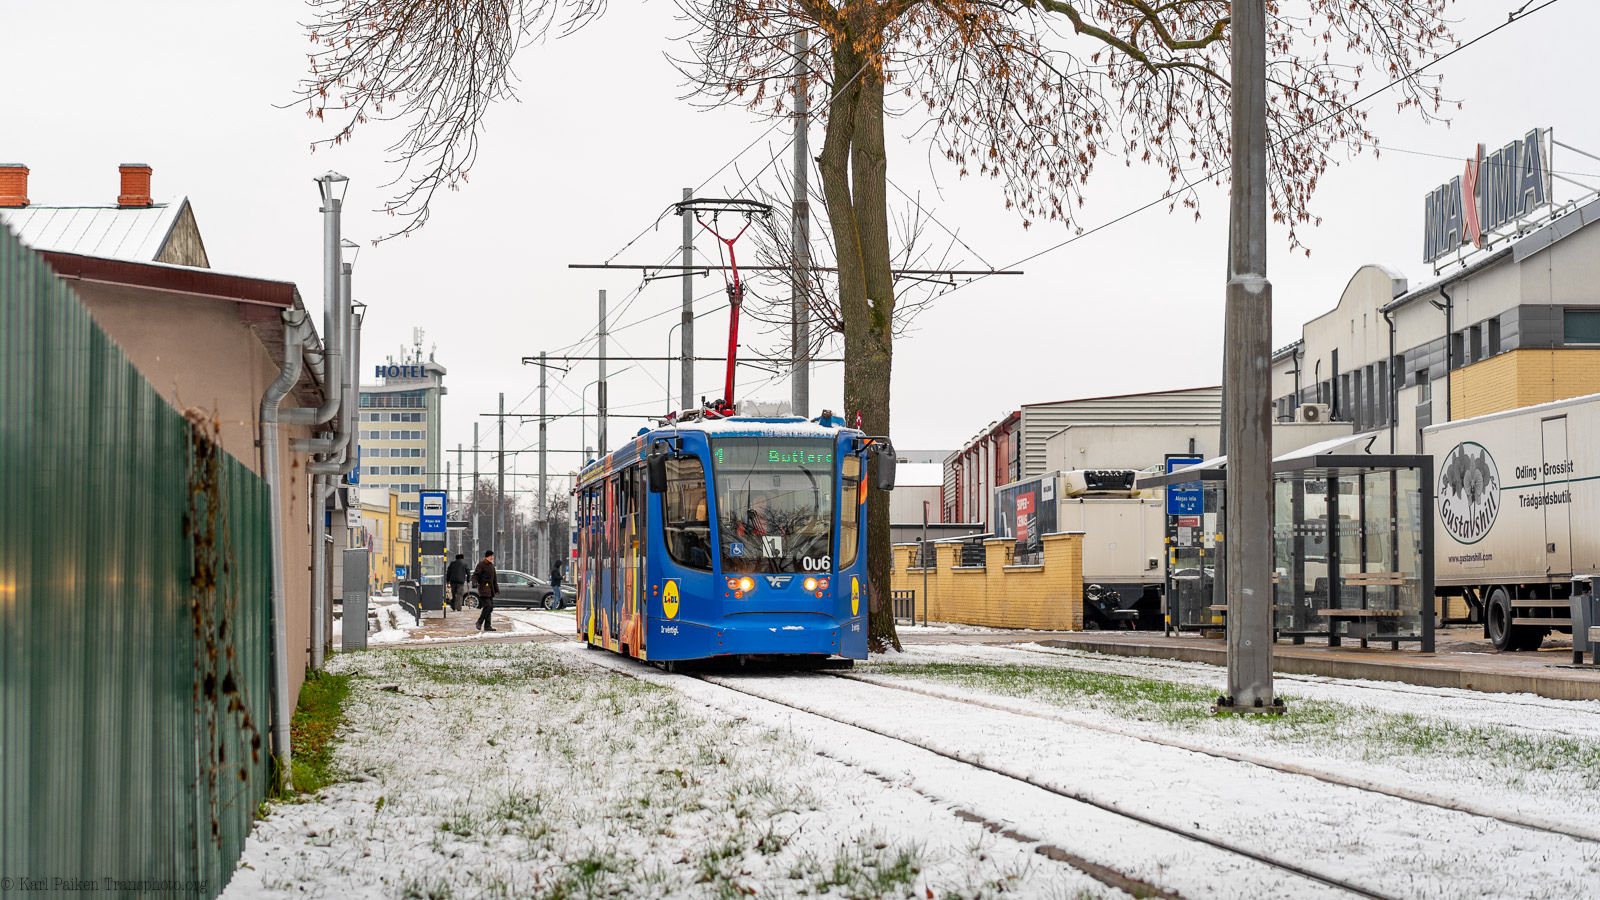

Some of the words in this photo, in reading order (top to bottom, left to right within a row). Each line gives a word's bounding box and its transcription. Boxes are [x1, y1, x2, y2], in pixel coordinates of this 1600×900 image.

[1423, 127, 1549, 264] MAXIMA
[375, 365, 429, 378] HOTEL
[714, 448, 723, 464] 1
[1515, 465, 1537, 480] Odling
[1543, 459, 1574, 476] Grossist
[1442, 491, 1497, 539] Gustavshill
[1448, 552, 1493, 564] www.gustavshill.com
